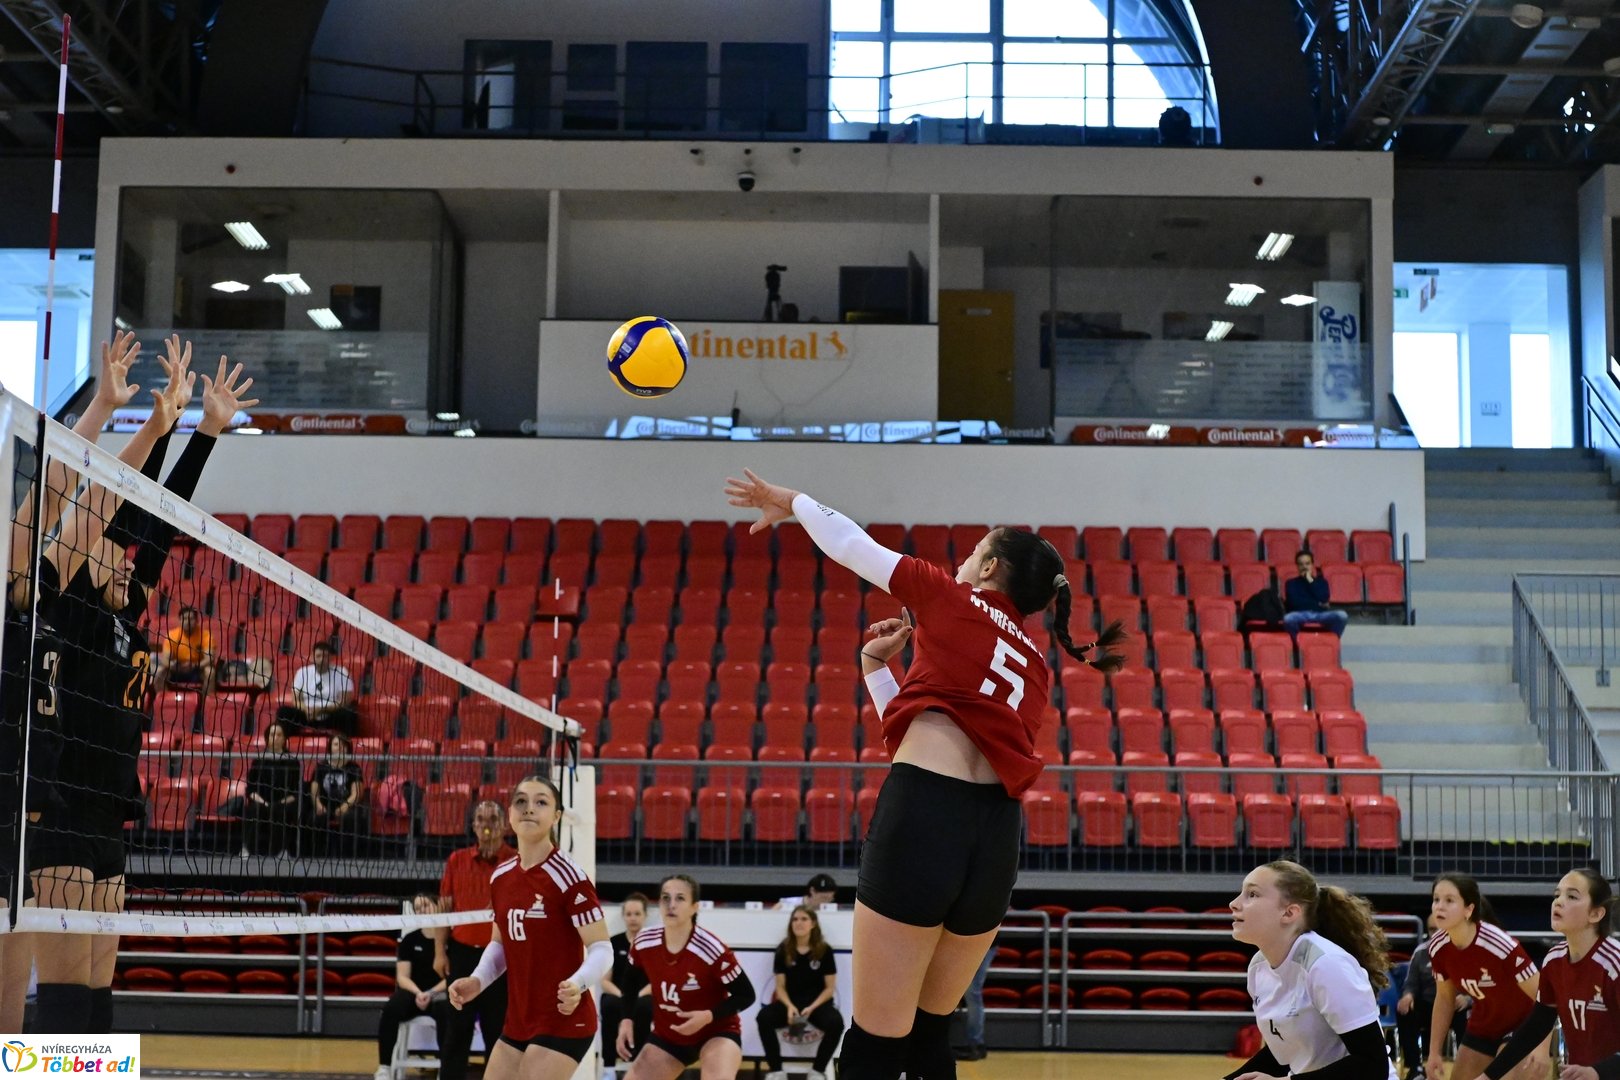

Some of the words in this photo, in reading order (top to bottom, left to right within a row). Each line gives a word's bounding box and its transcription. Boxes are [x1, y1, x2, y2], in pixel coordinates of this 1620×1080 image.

[690, 329, 820, 360] tinental
[290, 416, 356, 432] Continental
[1208, 428, 1274, 444] Continental
[37, 651, 60, 716] 3
[979, 636, 1028, 712] 5
[507, 908, 527, 941] 16
[661, 981, 680, 1005] 14
[1461, 978, 1486, 1000] 10
[1568, 998, 1587, 1031] 17
[1269, 1019, 1284, 1041] 4
